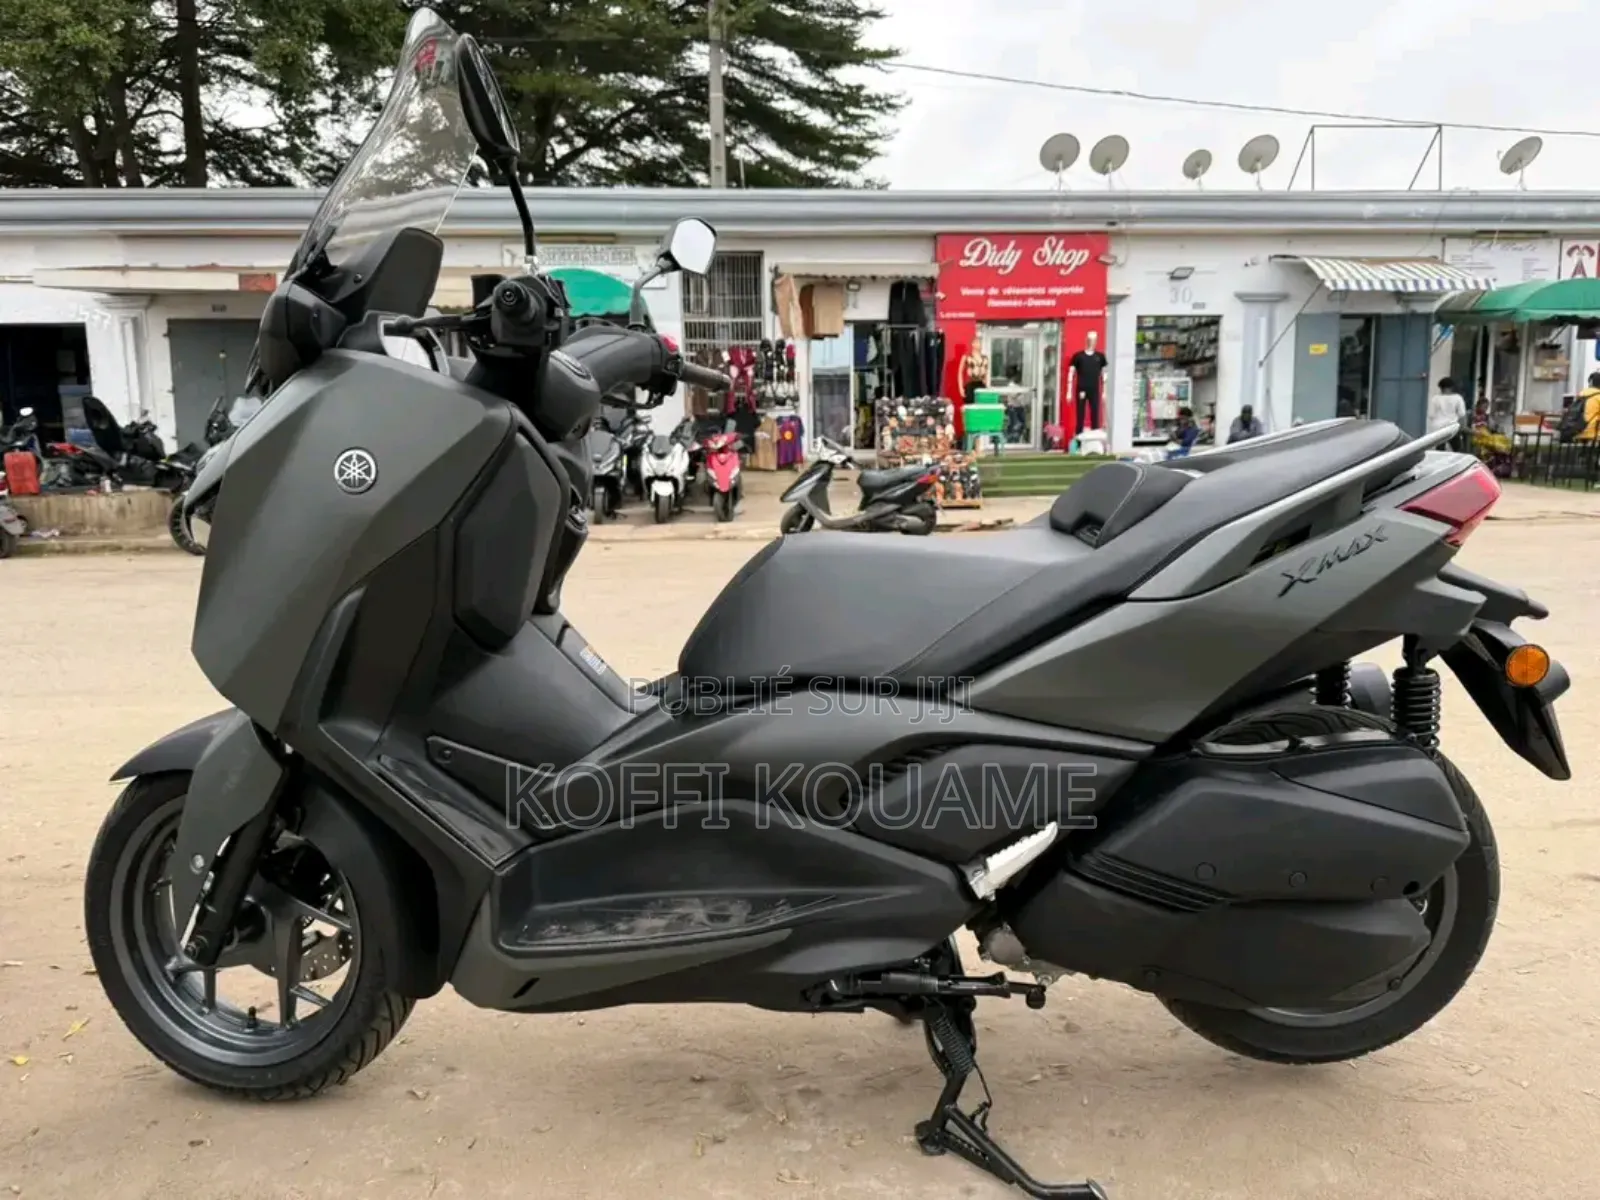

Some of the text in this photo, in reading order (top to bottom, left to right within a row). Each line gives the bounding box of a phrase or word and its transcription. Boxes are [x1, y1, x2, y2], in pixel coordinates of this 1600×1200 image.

[959, 236, 1090, 276] Didy Shop
[1278, 524, 1388, 598] XMAX
